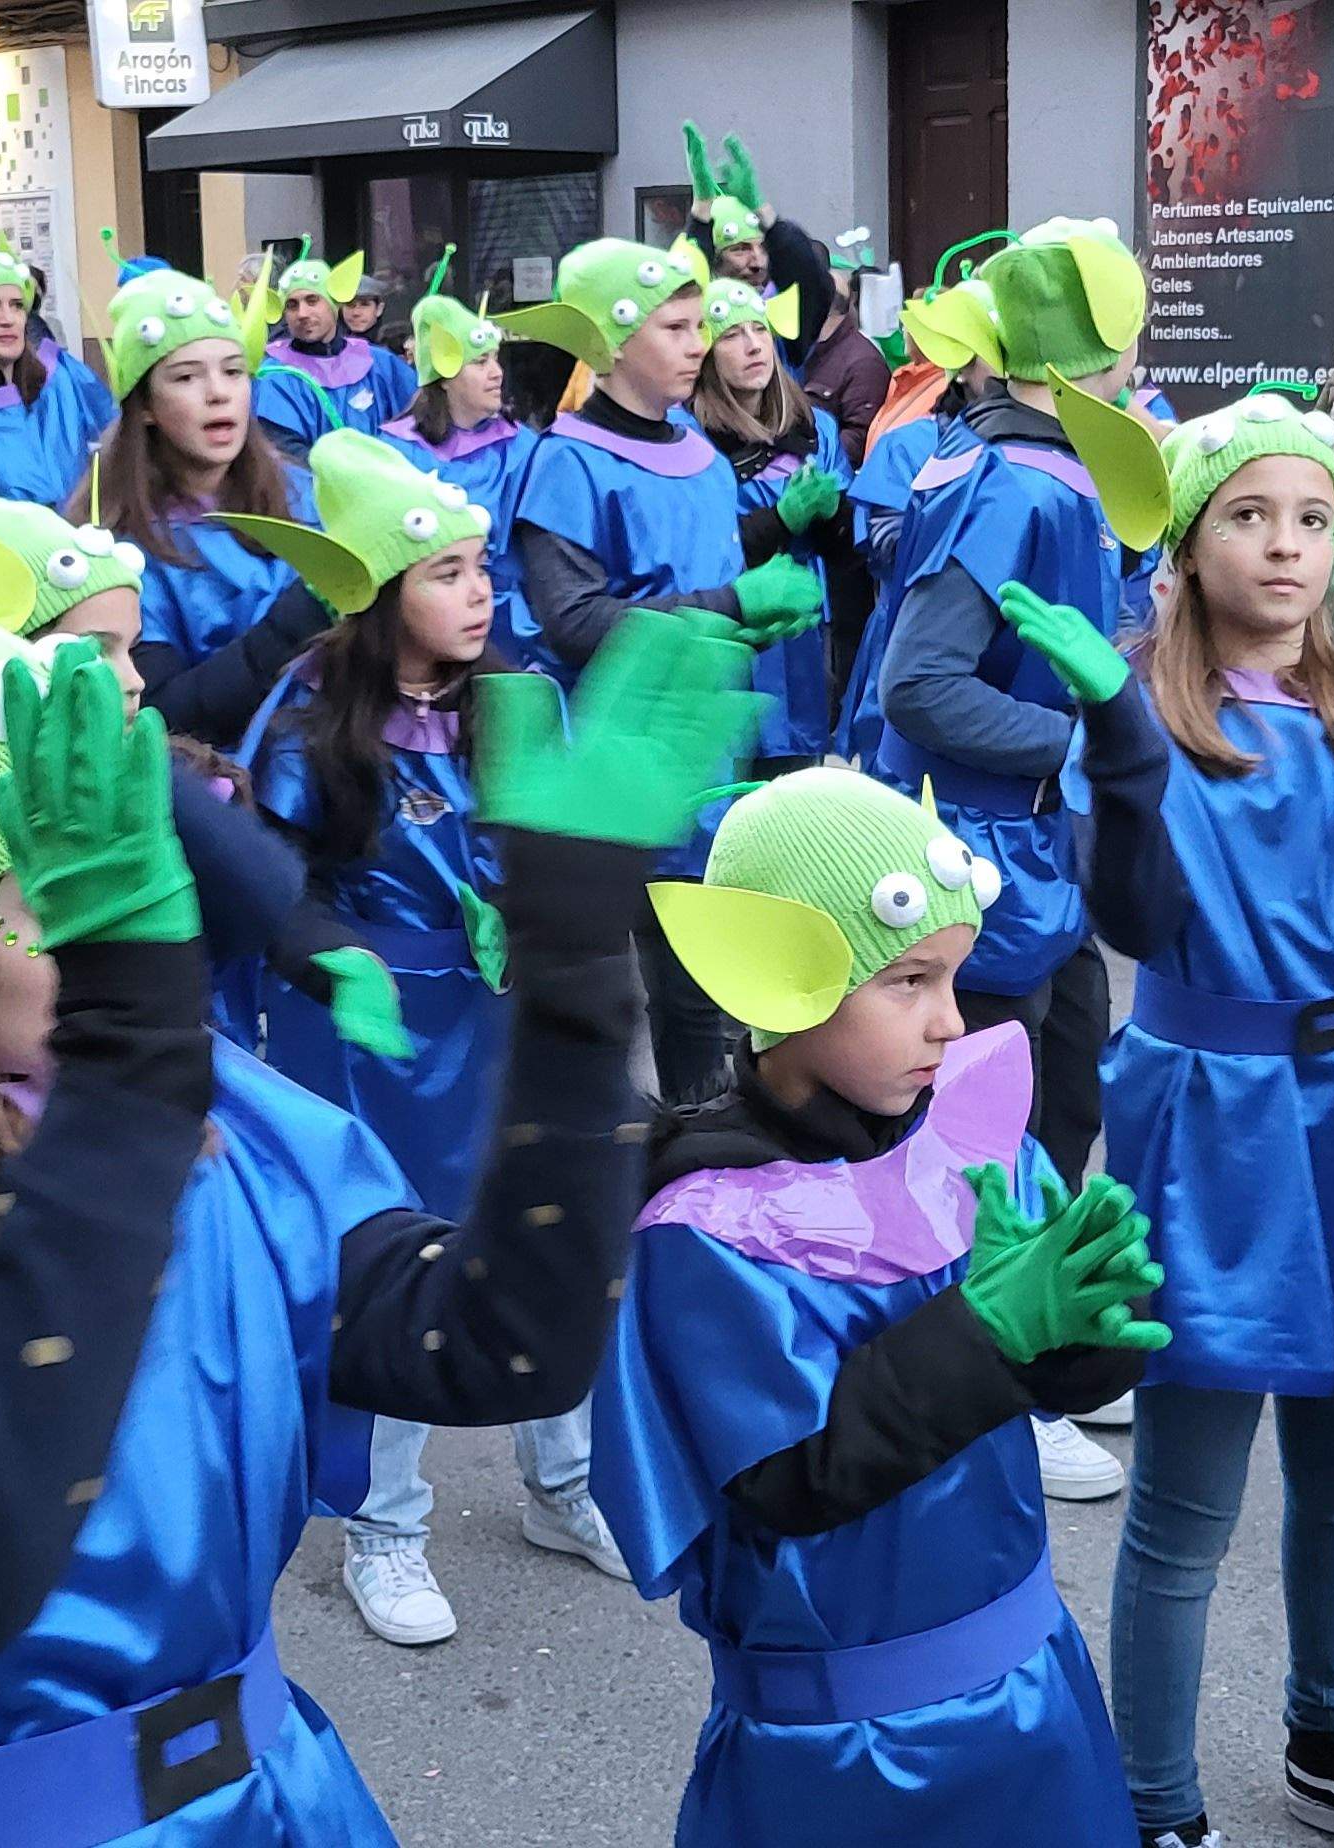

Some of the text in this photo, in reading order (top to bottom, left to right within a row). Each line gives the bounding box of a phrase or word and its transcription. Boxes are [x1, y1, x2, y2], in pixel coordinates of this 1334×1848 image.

[118, 48, 192, 73] Aragón
[124, 75, 187, 94] Fincas
[402, 115, 441, 147] quka
[463, 113, 510, 145] quka
[1152, 201, 1221, 219] Perfumes
[1225, 200, 1243, 216] de
[1151, 227, 1294, 246] Jabones Artesanos
[1151, 251, 1262, 270] Ambientadores
[1151, 277, 1193, 293] Geles
[1150, 300, 1204, 317] Aceites
[1149, 324, 1233, 341] Inciensos...
